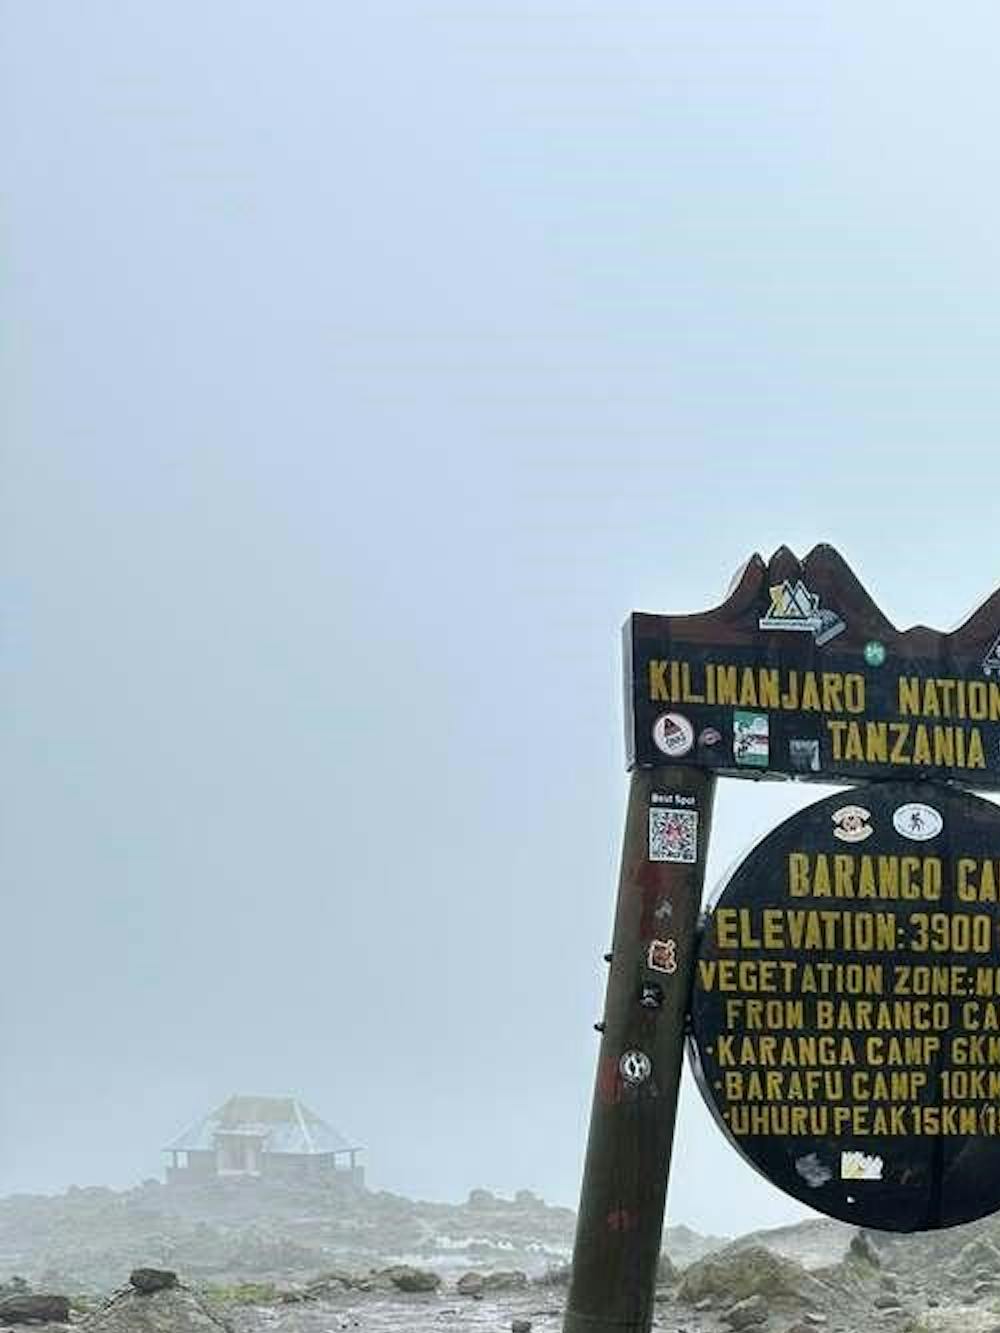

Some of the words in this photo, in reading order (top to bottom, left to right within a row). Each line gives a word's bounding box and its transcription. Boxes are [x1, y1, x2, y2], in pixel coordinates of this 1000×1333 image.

[649, 660, 865, 713] KILIMANJARO
[826, 720, 987, 769] TANZANIA
[909, 912, 992, 953] 3900
[699, 958, 884, 994] VEGETATION
[726, 1000, 804, 1030] FROM
[717, 1035, 856, 1067] KARANGA
[866, 1035, 941, 1066] CAMP
[725, 1070, 844, 1100] BARAFU
[852, 1070, 927, 1101] CAMP
[730, 1105, 828, 1136] UHURU
[833, 1105, 908, 1136] PEAK
